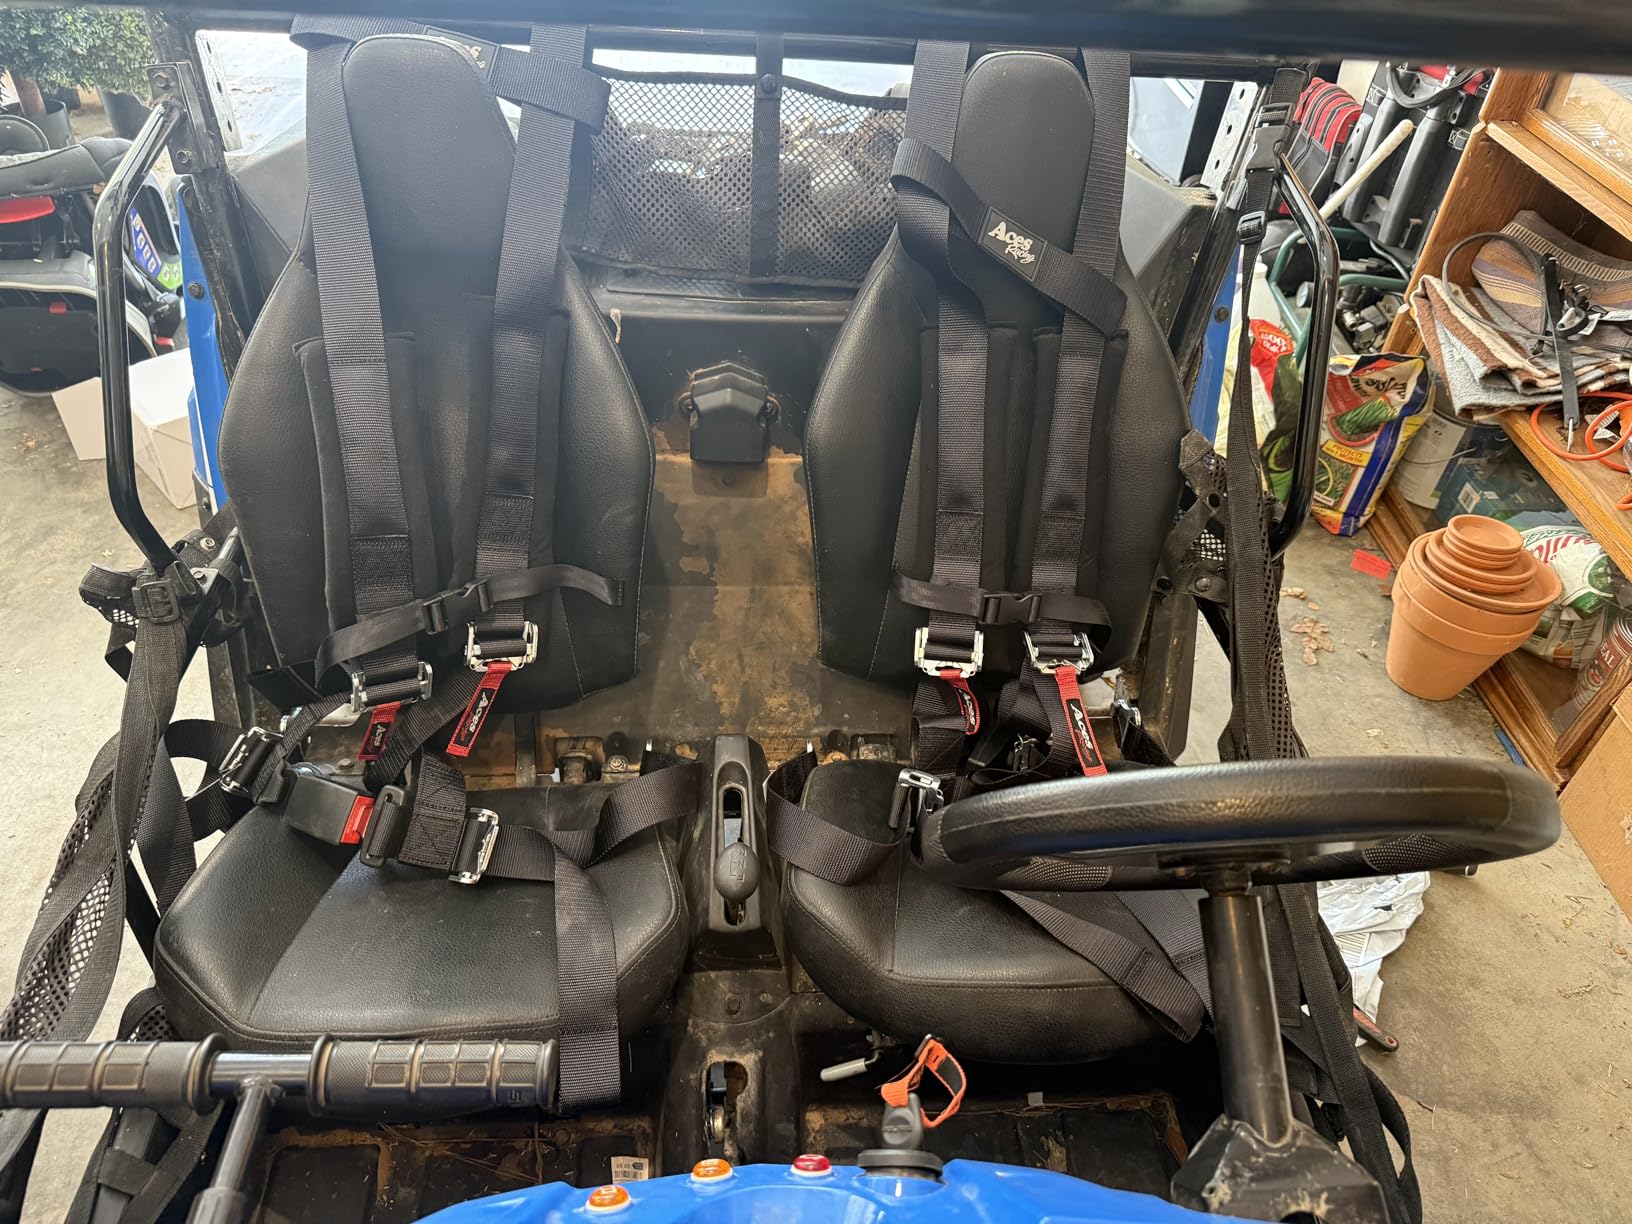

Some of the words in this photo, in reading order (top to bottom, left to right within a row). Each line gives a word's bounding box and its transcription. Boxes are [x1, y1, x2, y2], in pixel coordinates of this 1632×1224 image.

[988, 221, 1033, 251] Aces
[1004, 243, 1035, 264] Racing
[470, 691, 489, 733] Aces
[1070, 703, 1094, 750] Aces
